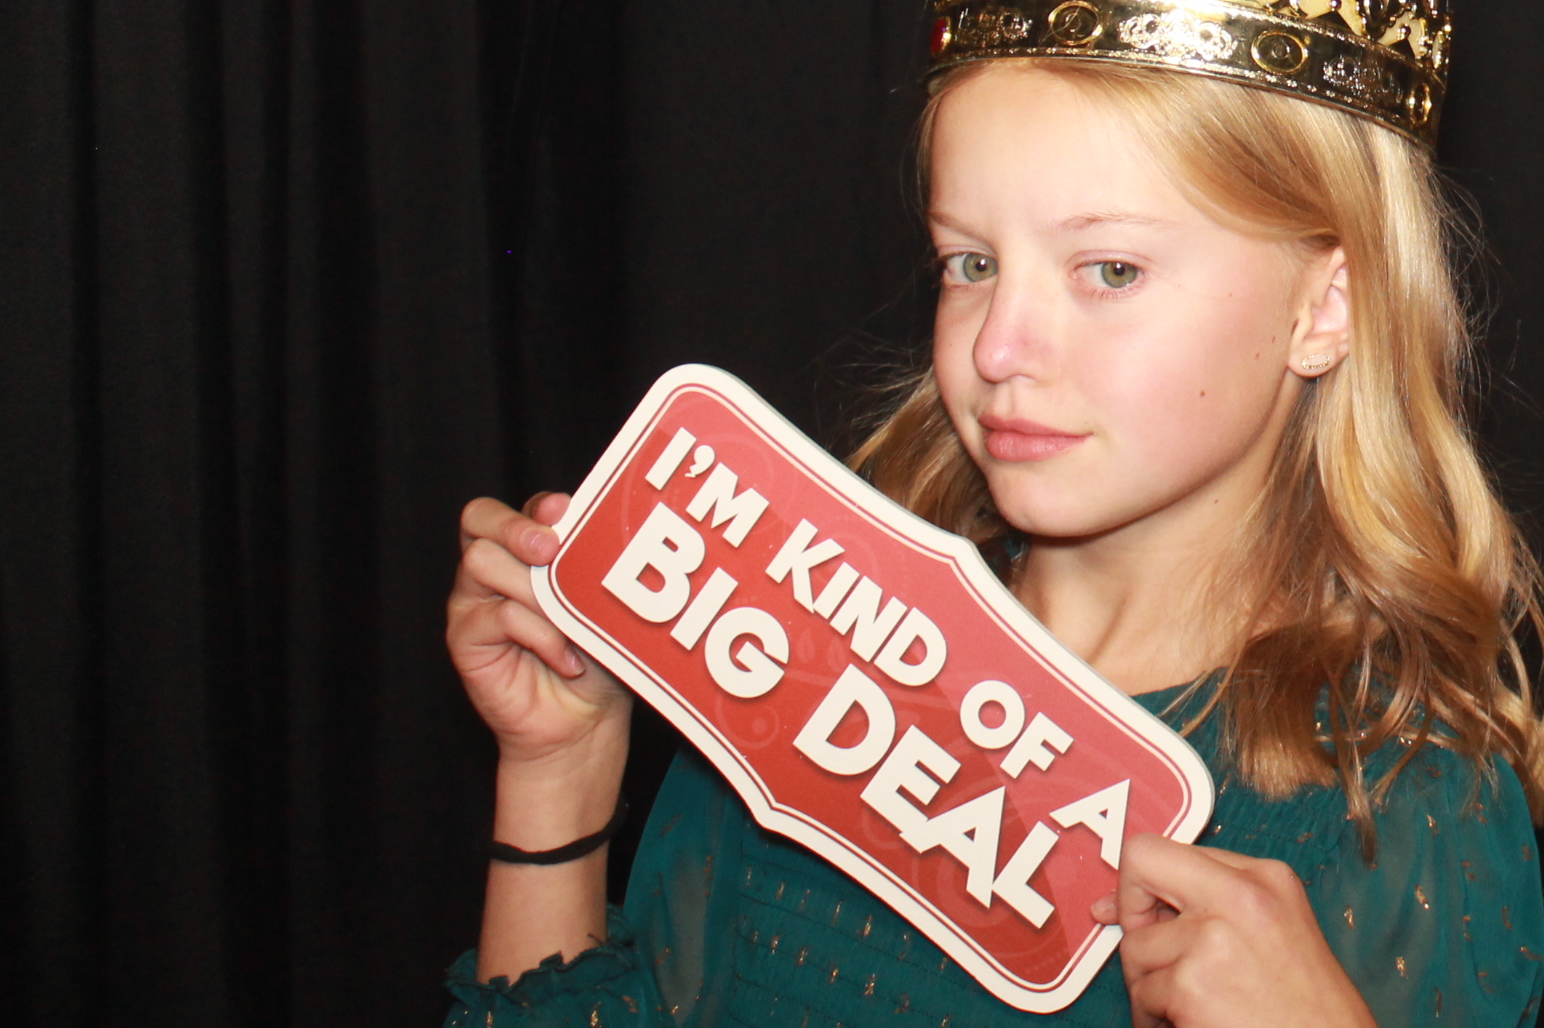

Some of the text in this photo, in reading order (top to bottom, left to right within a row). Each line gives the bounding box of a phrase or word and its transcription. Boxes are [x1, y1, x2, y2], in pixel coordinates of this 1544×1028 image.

[601, 501, 1060, 929] BIG DEAL
[644, 427, 1130, 870] I'M KIND OF A
